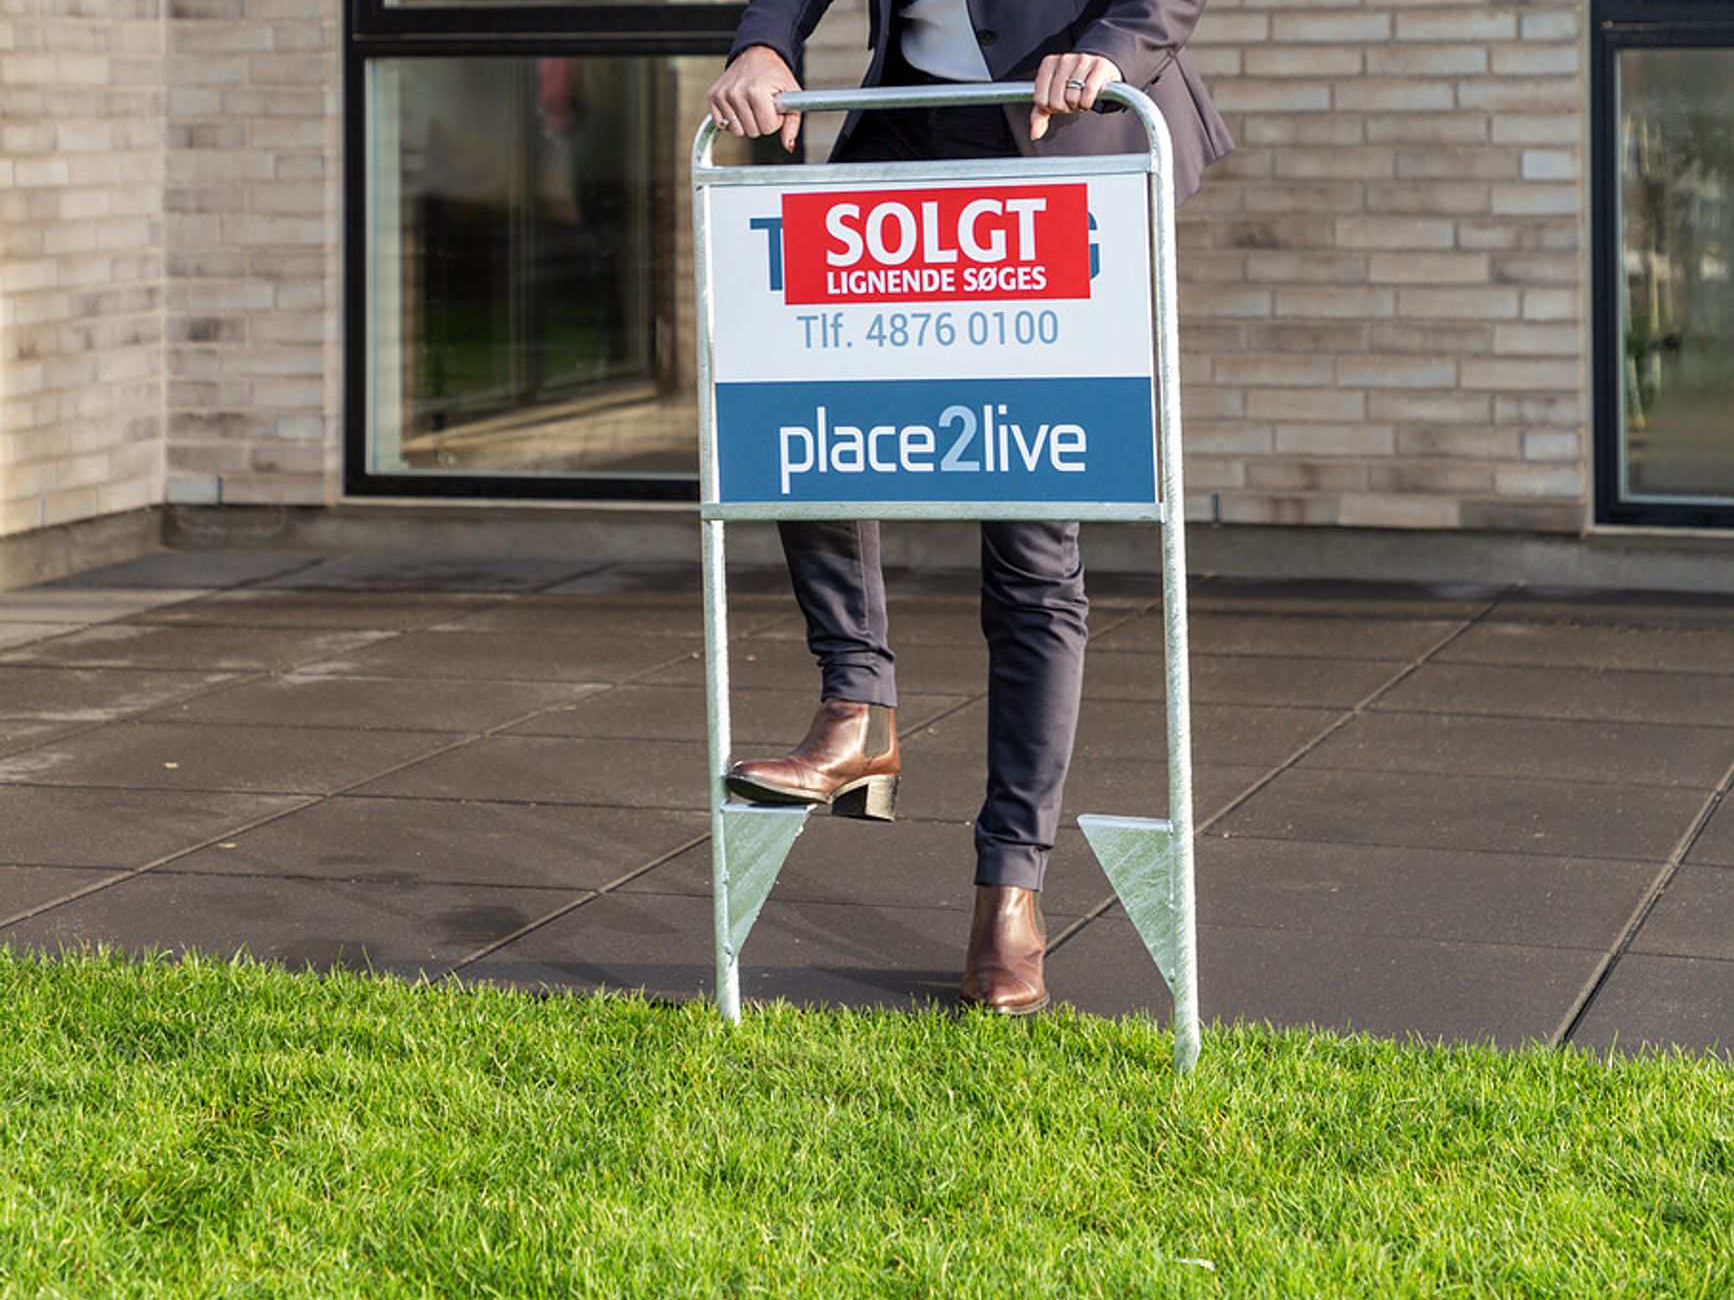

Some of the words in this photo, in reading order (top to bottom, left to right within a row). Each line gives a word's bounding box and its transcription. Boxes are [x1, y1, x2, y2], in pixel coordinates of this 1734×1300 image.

[825, 198, 1047, 266] SOLGT
[827, 269, 955, 295] LIGNENDE
[962, 266, 1047, 292] SØGES
[796, 313, 853, 349] Tlf.
[866, 312, 956, 347] 4876
[967, 310, 1059, 346] 0100
[779, 404, 1087, 495] place2live
